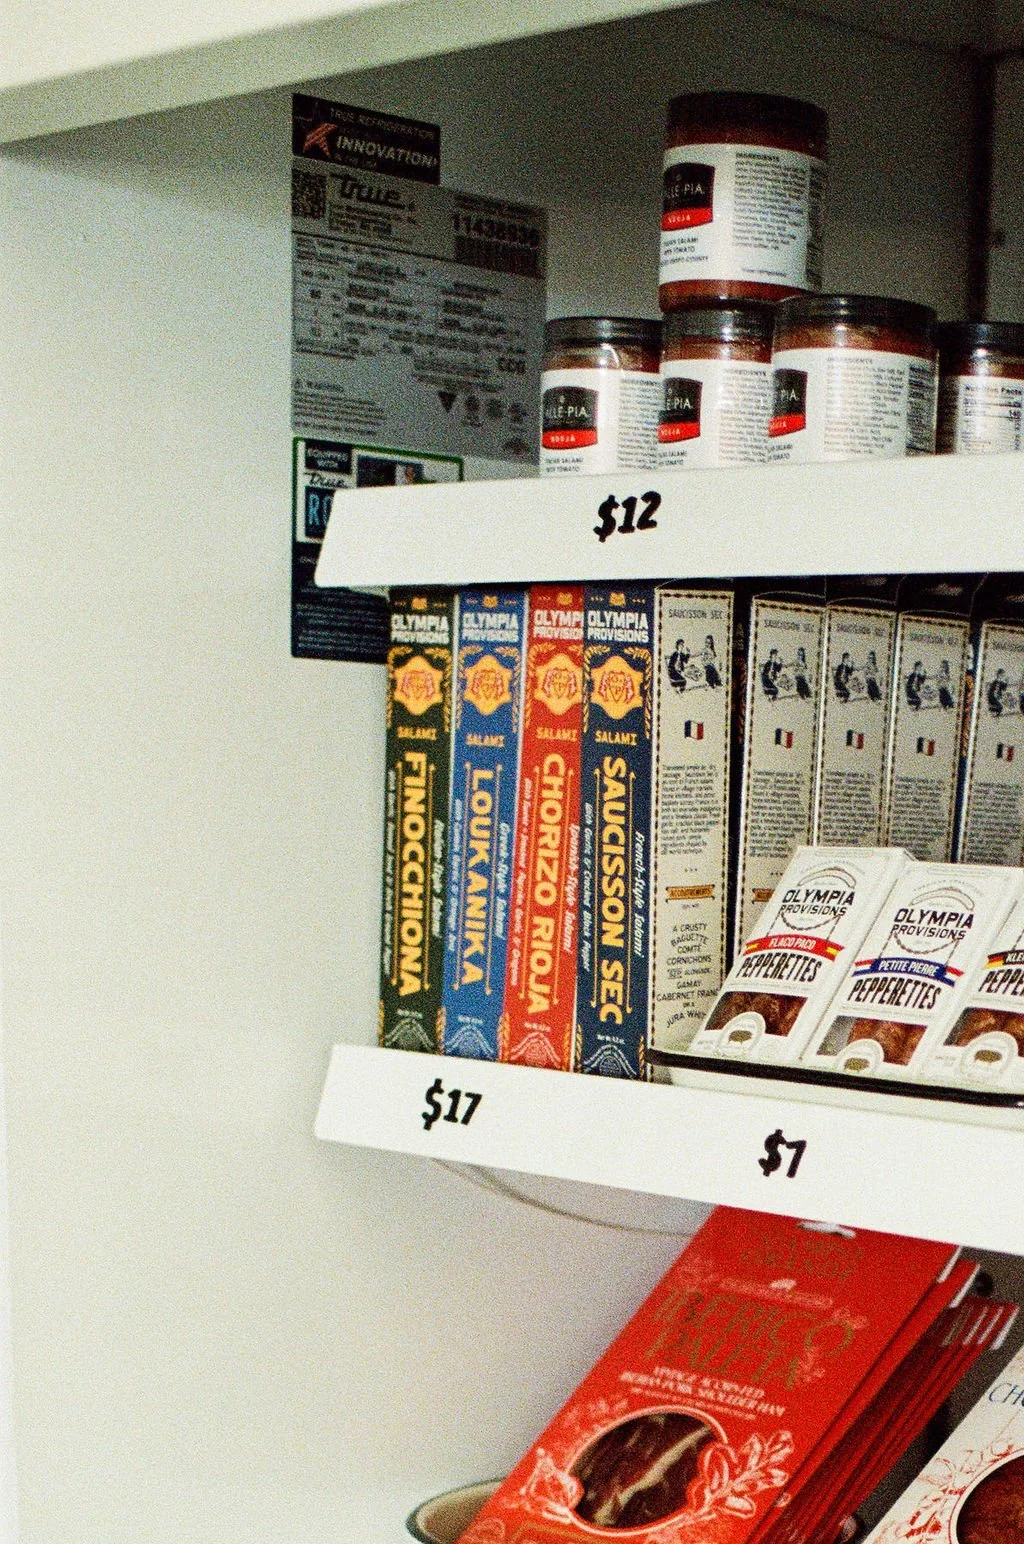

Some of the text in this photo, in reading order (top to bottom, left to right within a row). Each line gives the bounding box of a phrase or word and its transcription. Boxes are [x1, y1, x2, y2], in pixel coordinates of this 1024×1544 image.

[336, 135, 432, 168] INNOVATION
[593, 490, 662, 543] $12
[390, 613, 450, 630] OLYMPIA
[462, 612, 519, 630] OLYMPIA
[532, 609, 584, 628] OLYMPI
[587, 611, 650, 630] OLYMPIA
[390, 629, 450, 644] PROVISIONS
[461, 628, 519, 643] PROVISIONS
[532, 627, 584, 641] PROVISION
[587, 628, 650, 643] PROVISIONS
[397, 726, 437, 740] SALAMI
[466, 733, 505, 747] SALAMI
[536, 727, 577, 742] SALAMI
[595, 729, 638, 746] SALAMI
[399, 751, 427, 996] FINOCCHIONA
[461, 769, 494, 984] LOUKANIKA
[528, 753, 565, 1014] CHORIZO RIOJA
[599, 755, 628, 1025] SAUCISSON SEC
[632, 830, 645, 958] French-Style Salami
[781, 888, 856, 906] OLYMPIA
[780, 903, 848, 917] PROVISIONS
[894, 907, 975, 929] OLYMPIA
[893, 923, 966, 940] PROVISIONS
[736, 951, 823, 984] PEPPERETTES
[847, 976, 942, 1011] PEPPERETTES
[421, 1080, 482, 1132] $17
[758, 1129, 807, 1178] $7
